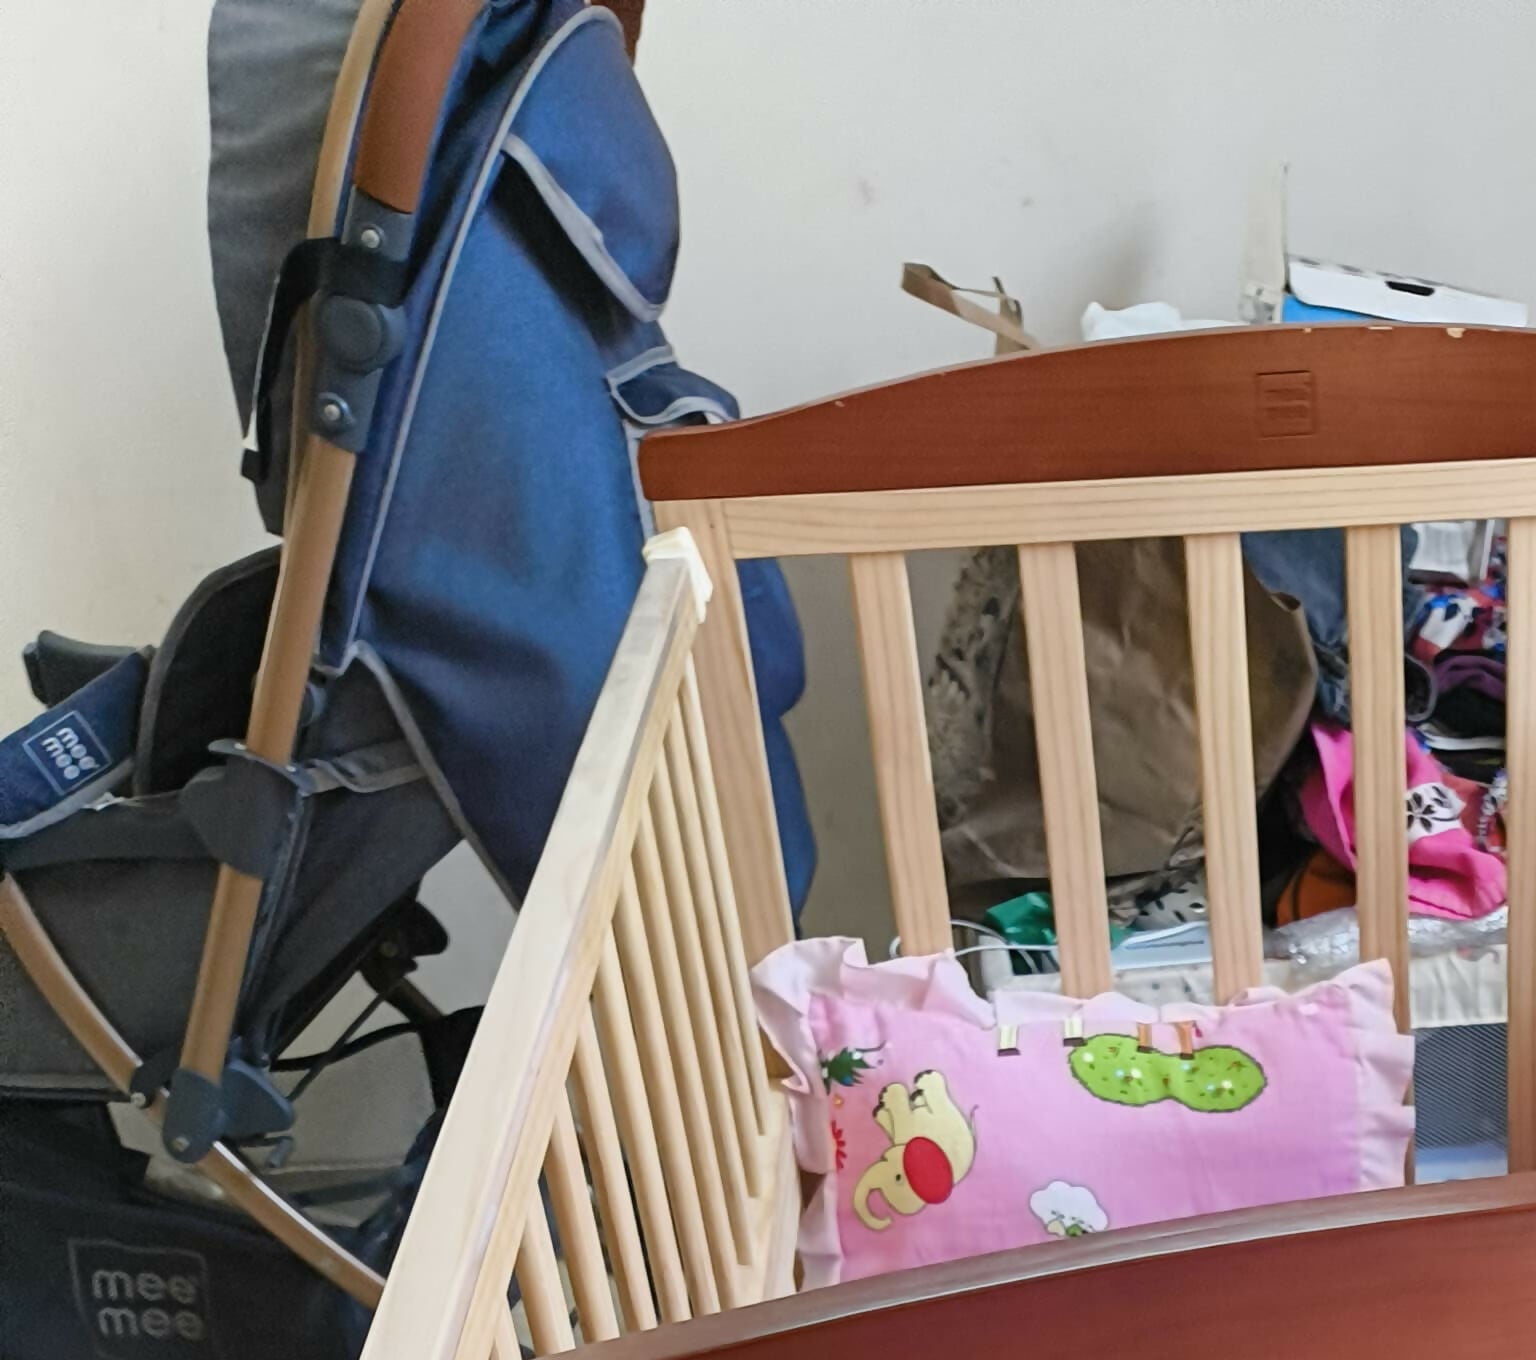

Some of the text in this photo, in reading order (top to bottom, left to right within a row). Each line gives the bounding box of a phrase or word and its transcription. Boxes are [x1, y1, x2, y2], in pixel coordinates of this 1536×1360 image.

[41, 737, 80, 779] mee
[56, 728, 95, 770] mee
[92, 1269, 196, 1305] mee
[99, 1306, 204, 1342] mee
